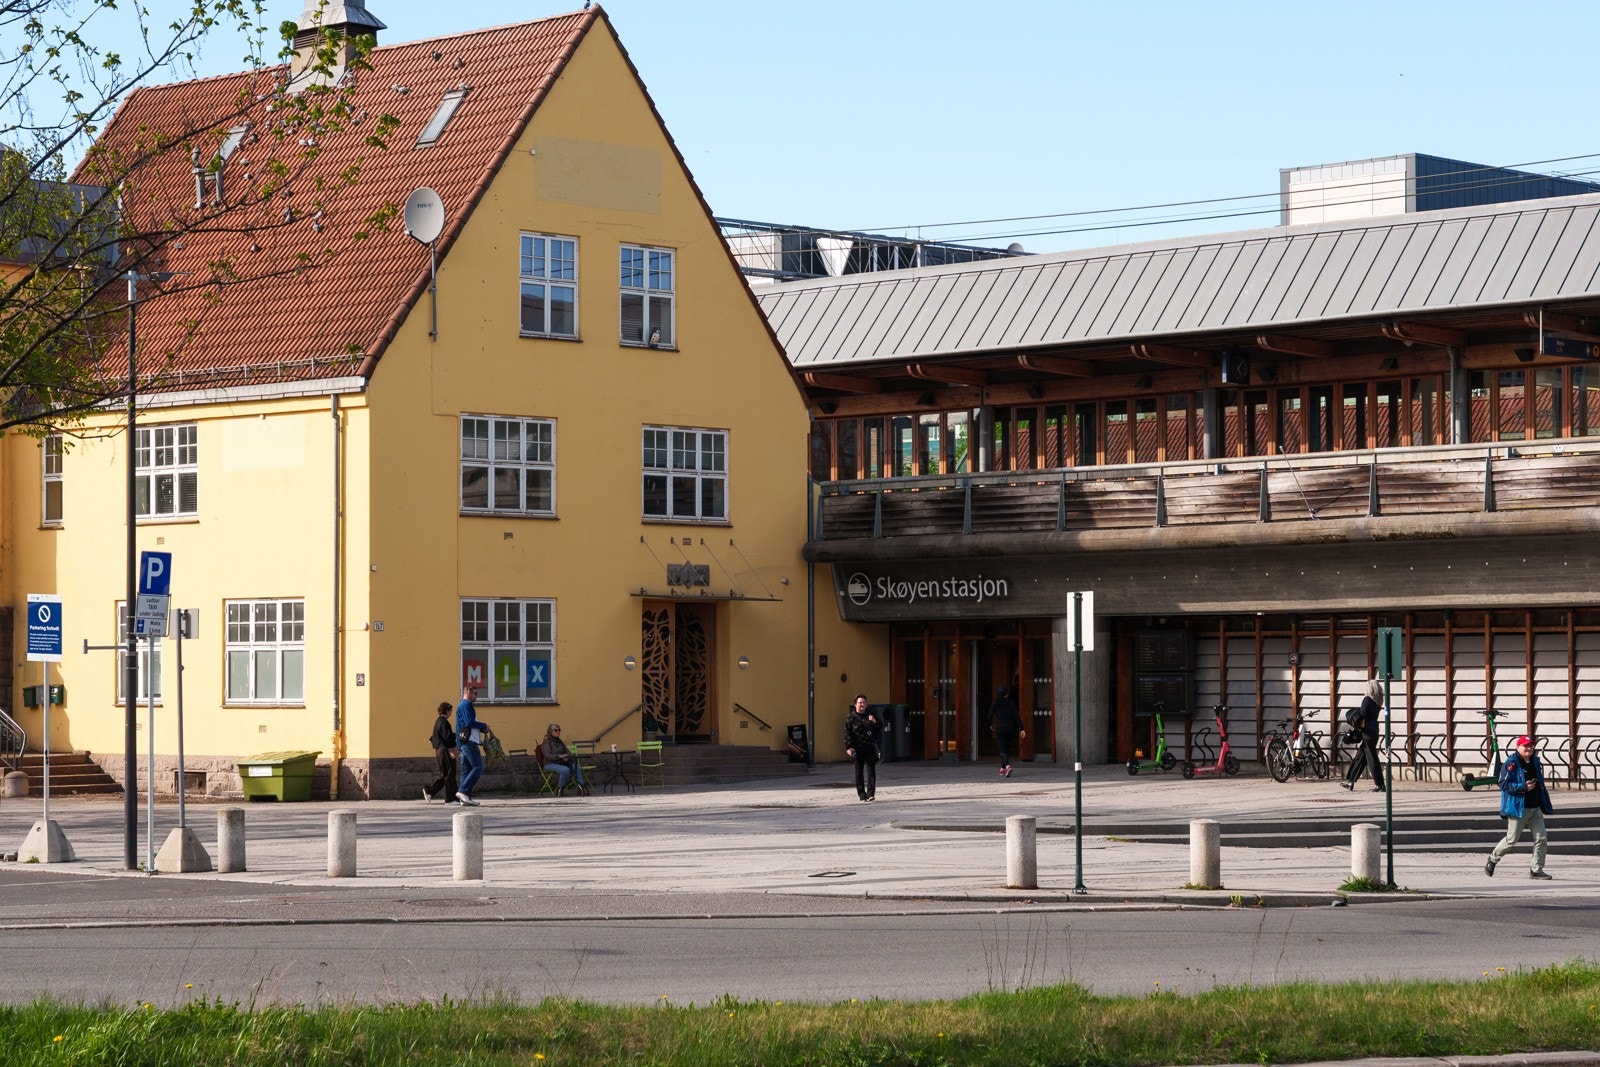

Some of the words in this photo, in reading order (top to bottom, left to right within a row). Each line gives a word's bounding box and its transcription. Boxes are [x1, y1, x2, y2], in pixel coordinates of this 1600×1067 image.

[146, 557, 164, 589] P
[876, 576, 940, 604] Skøyen
[942, 574, 1008, 603] stasjon
[467, 665, 544, 683] MIX
